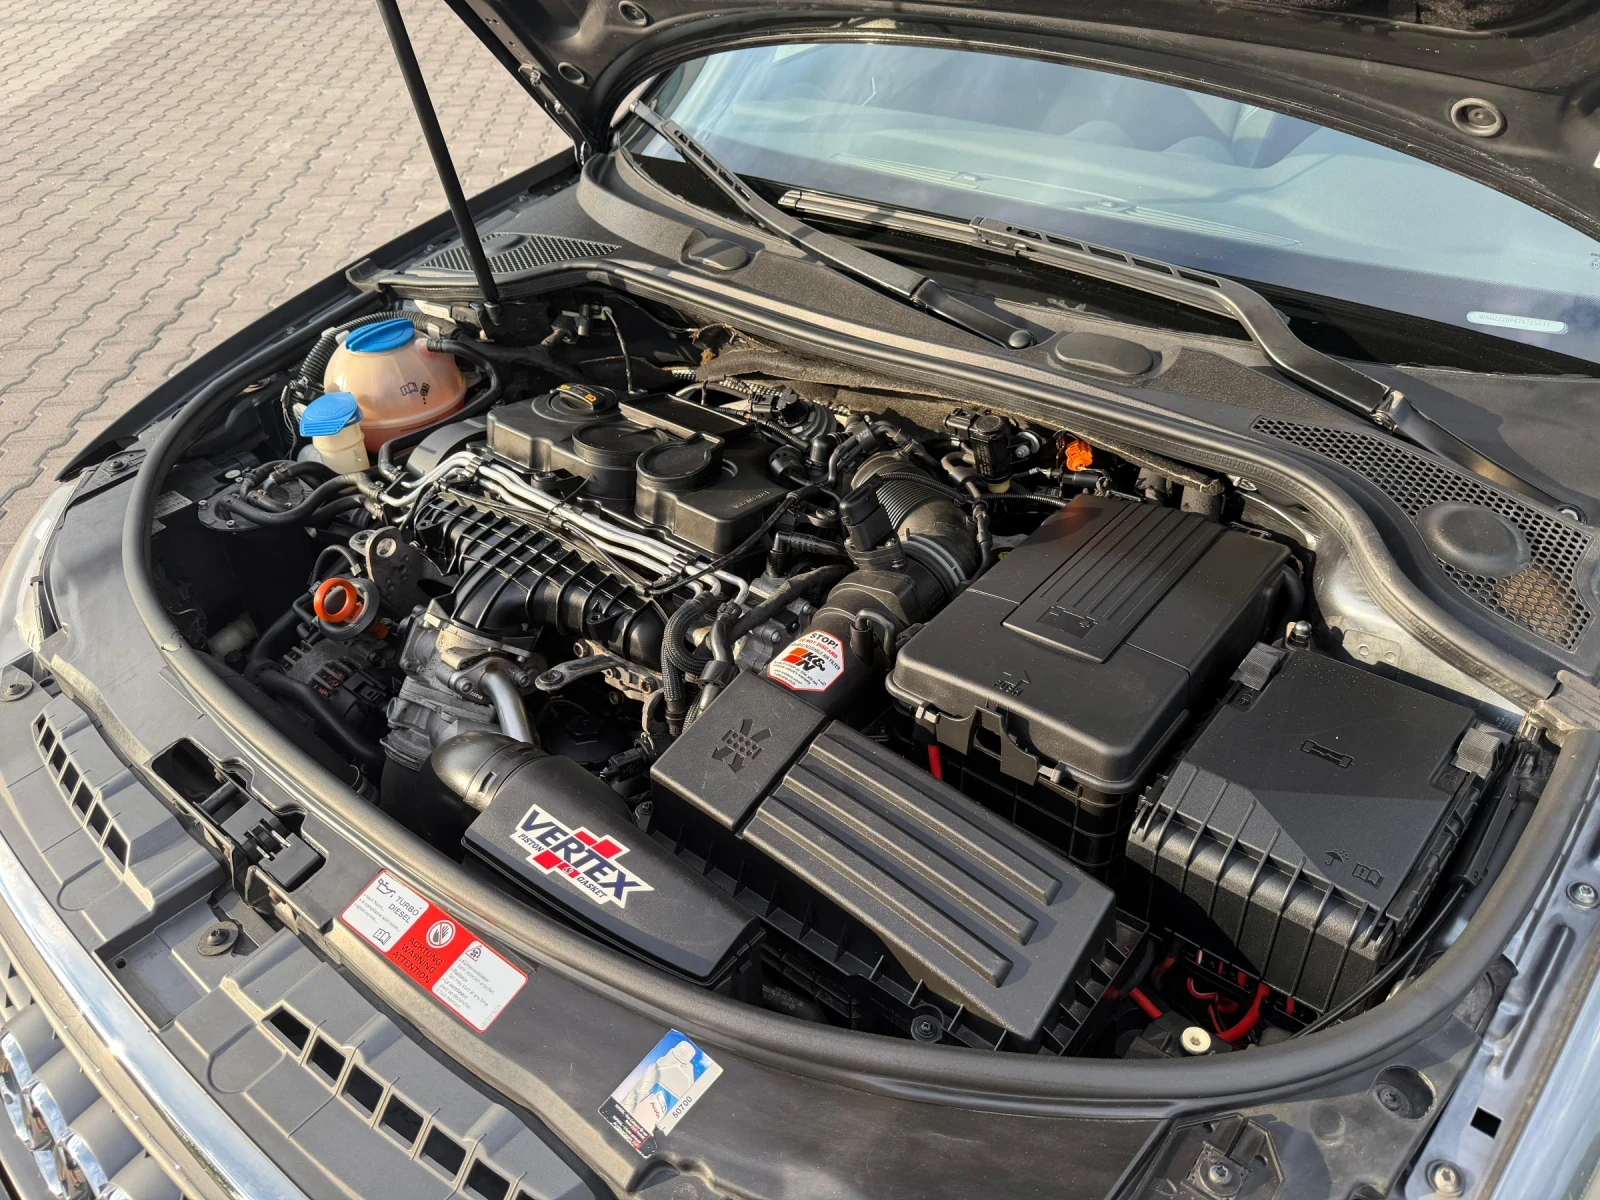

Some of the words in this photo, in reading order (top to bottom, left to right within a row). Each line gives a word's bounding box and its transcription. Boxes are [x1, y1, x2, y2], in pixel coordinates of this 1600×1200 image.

[810, 632, 839, 649] STOP!
[816, 642, 838, 659] DISCARD
[829, 658, 841, 671] FILTER
[992, 679, 1024, 696] PUSH
[518, 834, 545, 852] PISTON
[563, 866, 573, 874] &
[576, 876, 608, 898] GASKET
[520, 810, 642, 901] VERTEX
[388, 903, 411, 924] DIESEL
[396, 896, 420, 916] TURBO
[402, 944, 436, 974] WARNING
[409, 938, 442, 966] ACHTUNG
[392, 951, 432, 984] ATTENTION
[672, 1096, 692, 1118] 50700
